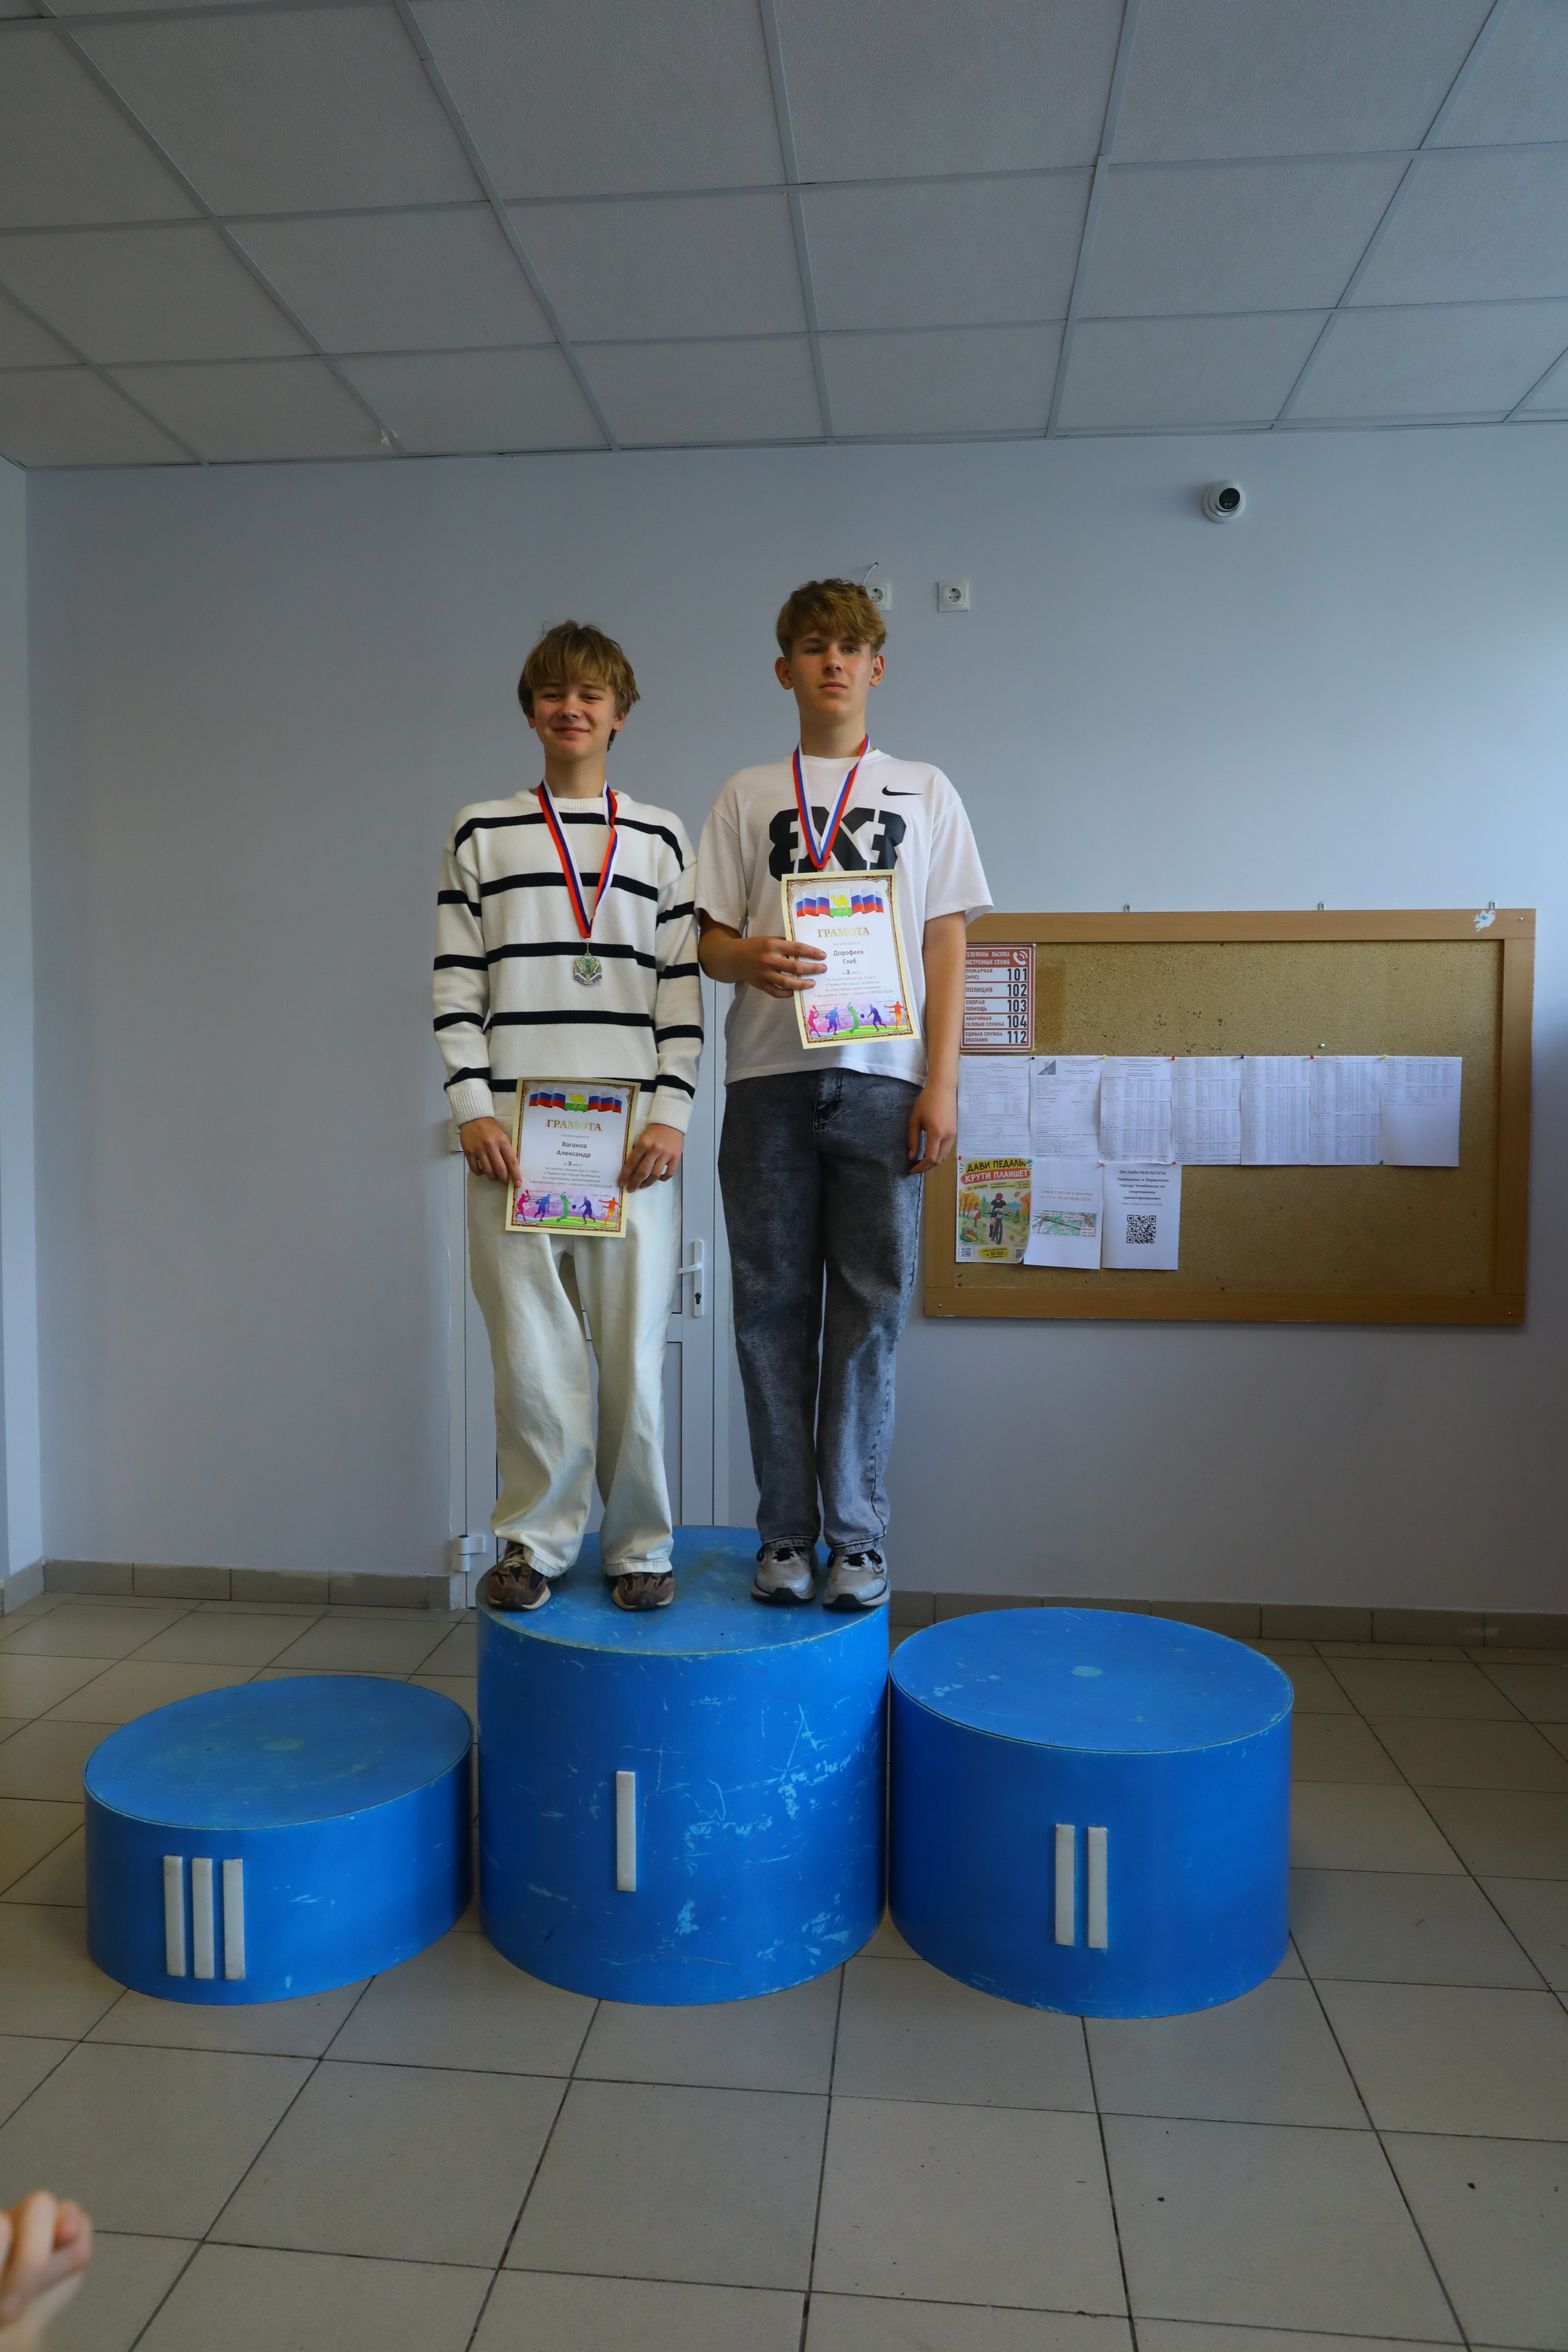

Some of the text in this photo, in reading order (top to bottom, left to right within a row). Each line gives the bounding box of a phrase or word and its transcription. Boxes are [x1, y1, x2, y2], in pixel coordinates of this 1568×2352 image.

[818, 927, 870, 937] ГРАМОТА
[1008, 968, 1027, 981] 101
[1008, 984, 1027, 996] 102
[1008, 1000, 1027, 1012] 103
[1008, 1015, 1027, 1028] 104
[1008, 1031, 1027, 1043] 112
[546, 1119, 602, 1131] ГРАМОТА
[556, 1150, 591, 1158] Александр
[967, 1159, 1026, 1172] ДАВИ ПЕДАЛЬ,
[965, 1170, 1028, 1183] КРУТИ ПЛАНШЕТ
